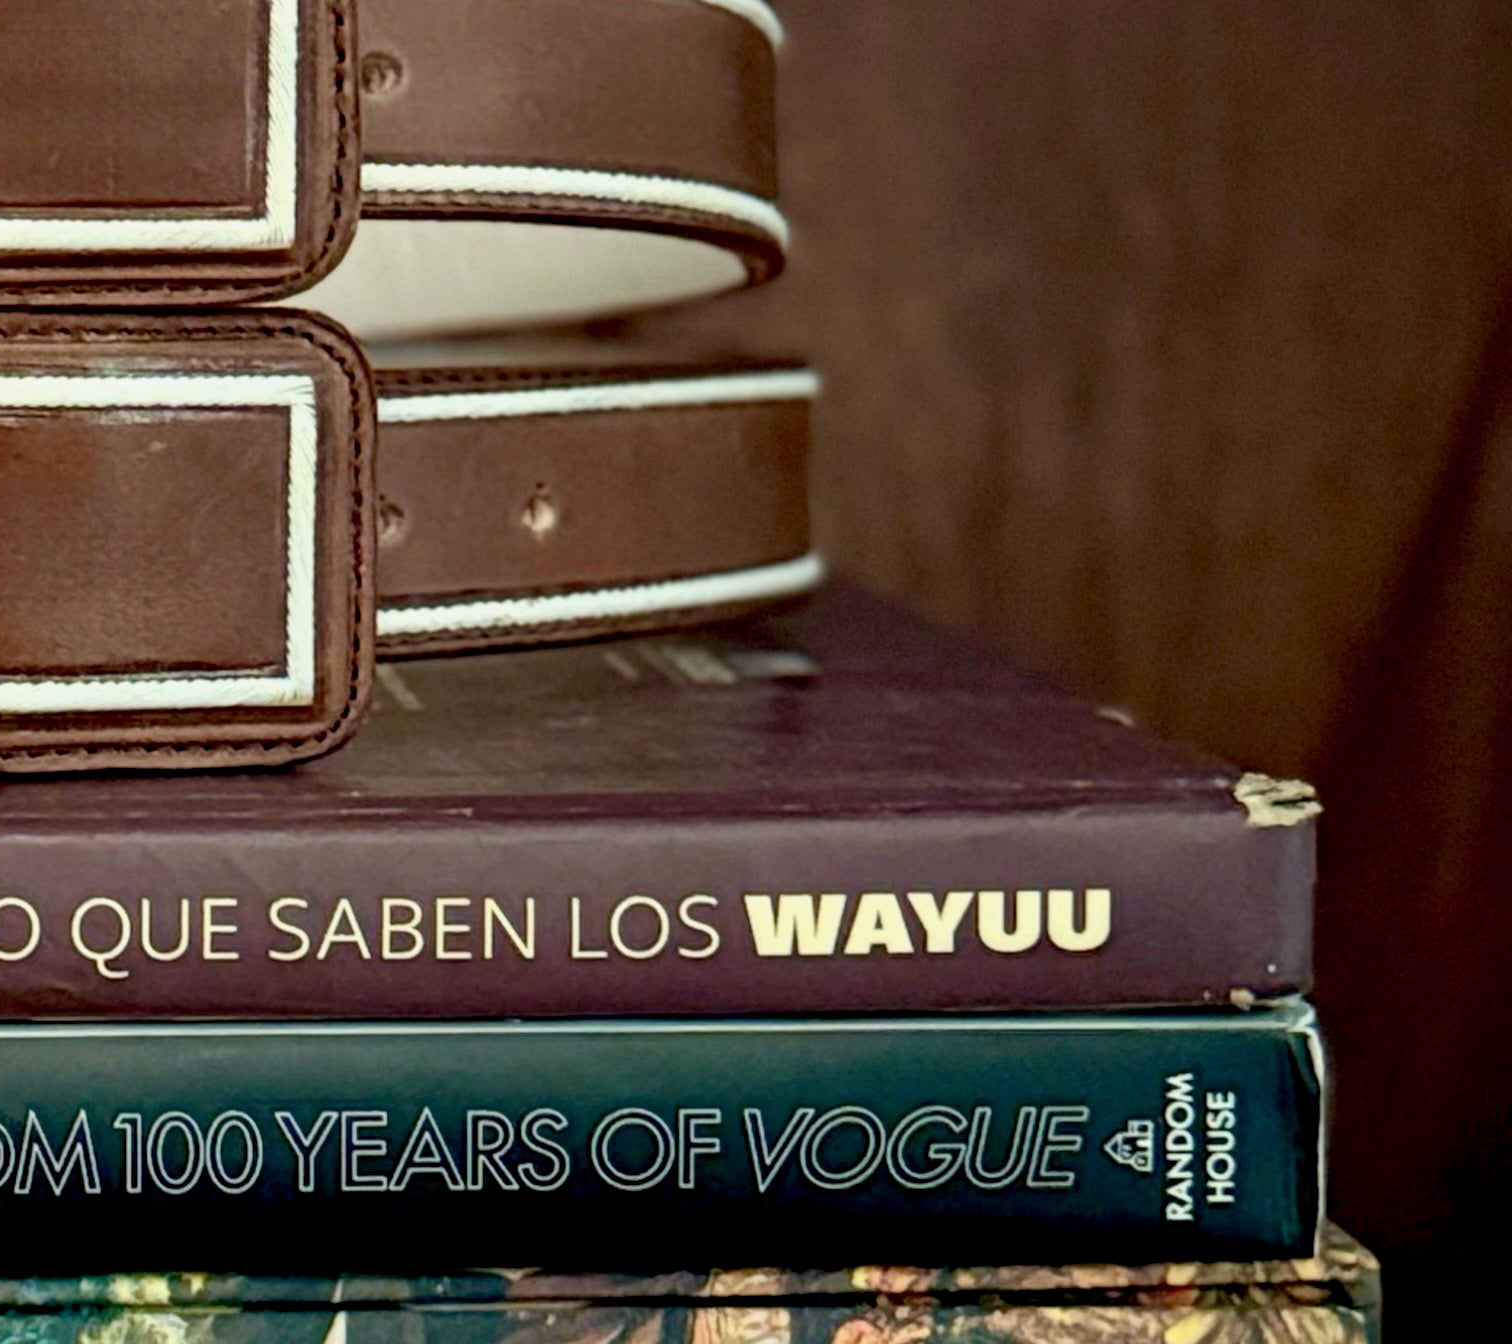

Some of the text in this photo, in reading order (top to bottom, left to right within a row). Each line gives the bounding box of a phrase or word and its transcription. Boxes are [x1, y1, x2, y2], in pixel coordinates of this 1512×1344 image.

[70, 896, 241, 979] QUE
[269, 895, 536, 962] SABEN
[570, 894, 721, 960] LOS
[744, 888, 1111, 957] WAYUU
[112, 1109, 264, 1196] 100
[276, 1108, 569, 1194] YEARS
[590, 1106, 723, 1192] OF
[744, 1104, 1090, 1192] VOGUE
[1165, 1071, 1196, 1222] RANDOM
[1208, 1088, 1238, 1205] HOUSE
